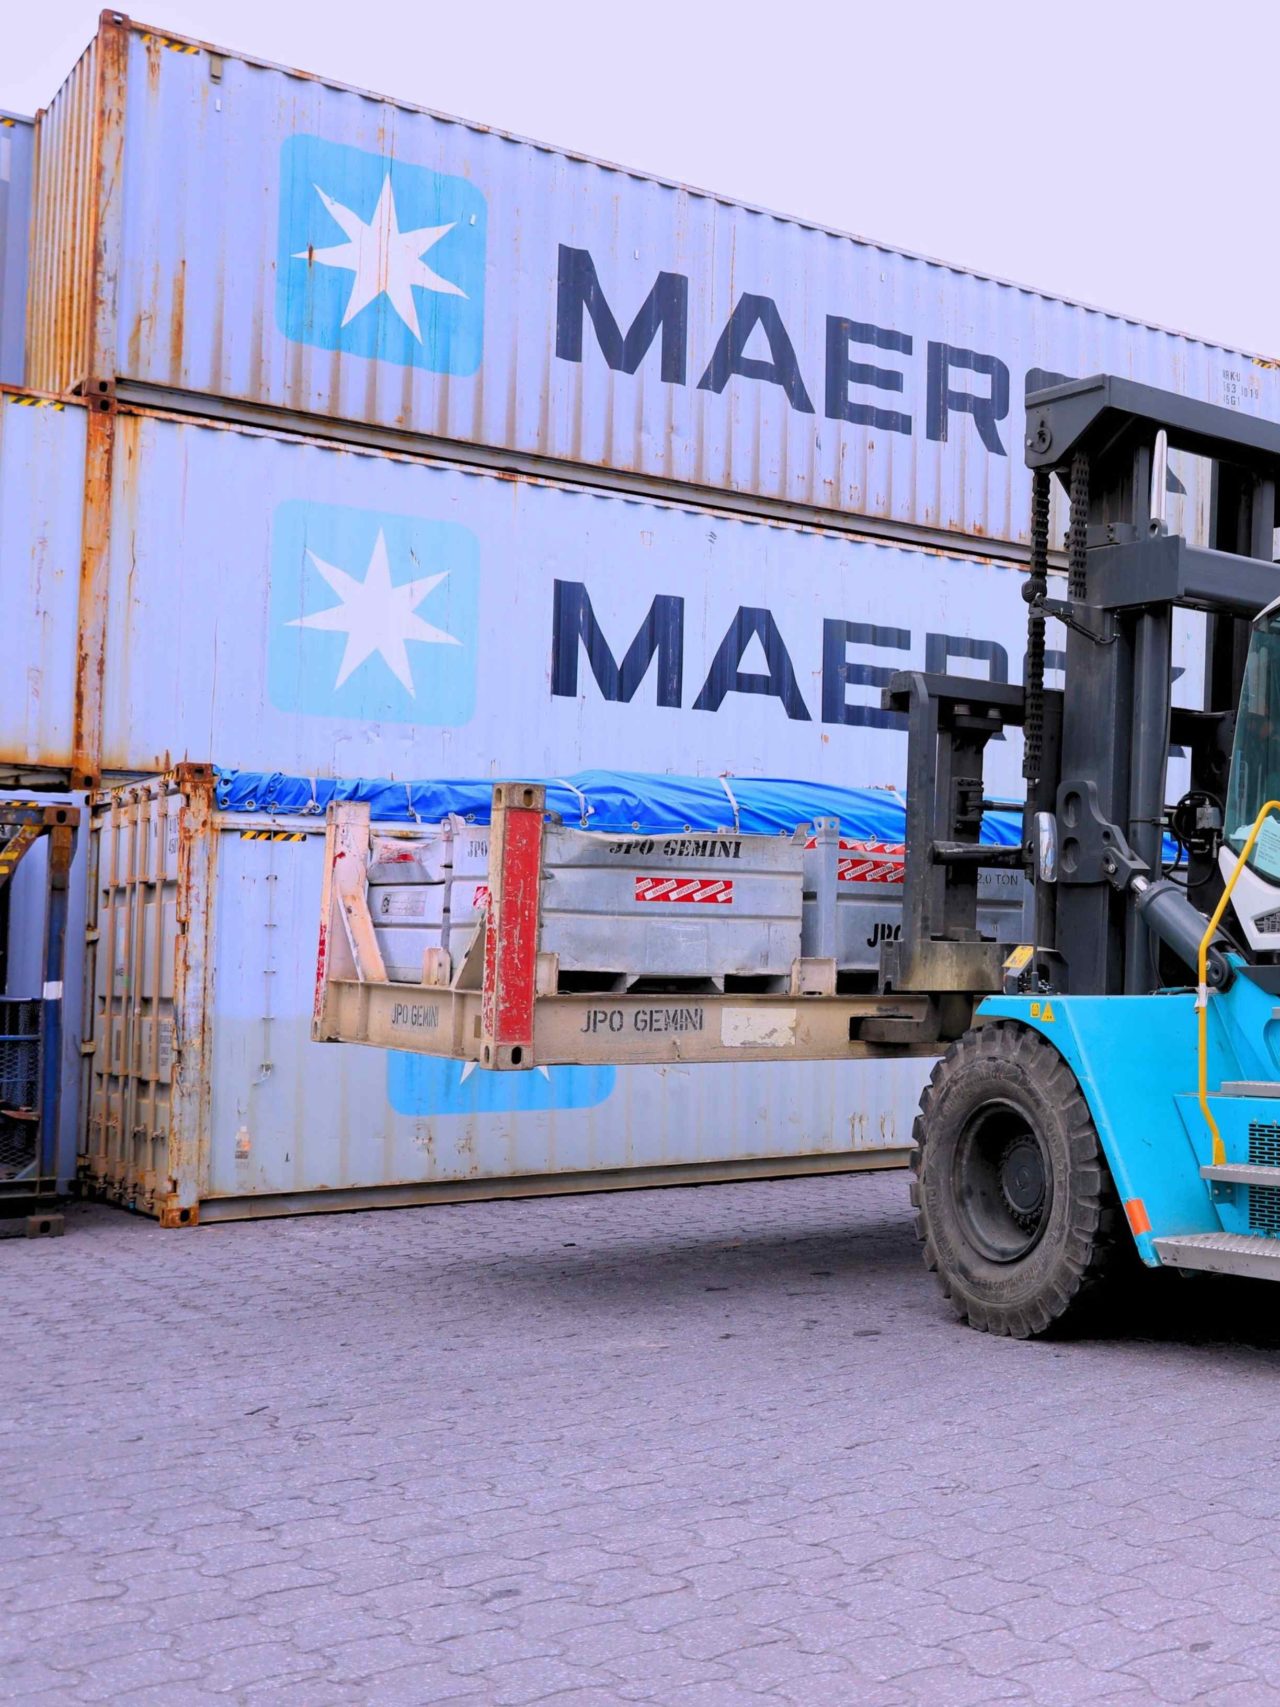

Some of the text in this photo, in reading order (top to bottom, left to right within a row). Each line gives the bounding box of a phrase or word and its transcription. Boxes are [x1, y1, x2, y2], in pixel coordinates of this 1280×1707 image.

[555, 243, 1187, 495] MAER
[551, 578, 1186, 759] MAE
[468, 840, 488, 857] JPO
[609, 839, 742, 859] JPO GEMINI
[995, 874, 1018, 886] TON
[391, 1004, 439, 1027] JPO GEMINI
[580, 1008, 703, 1033] JPO GEMINI
